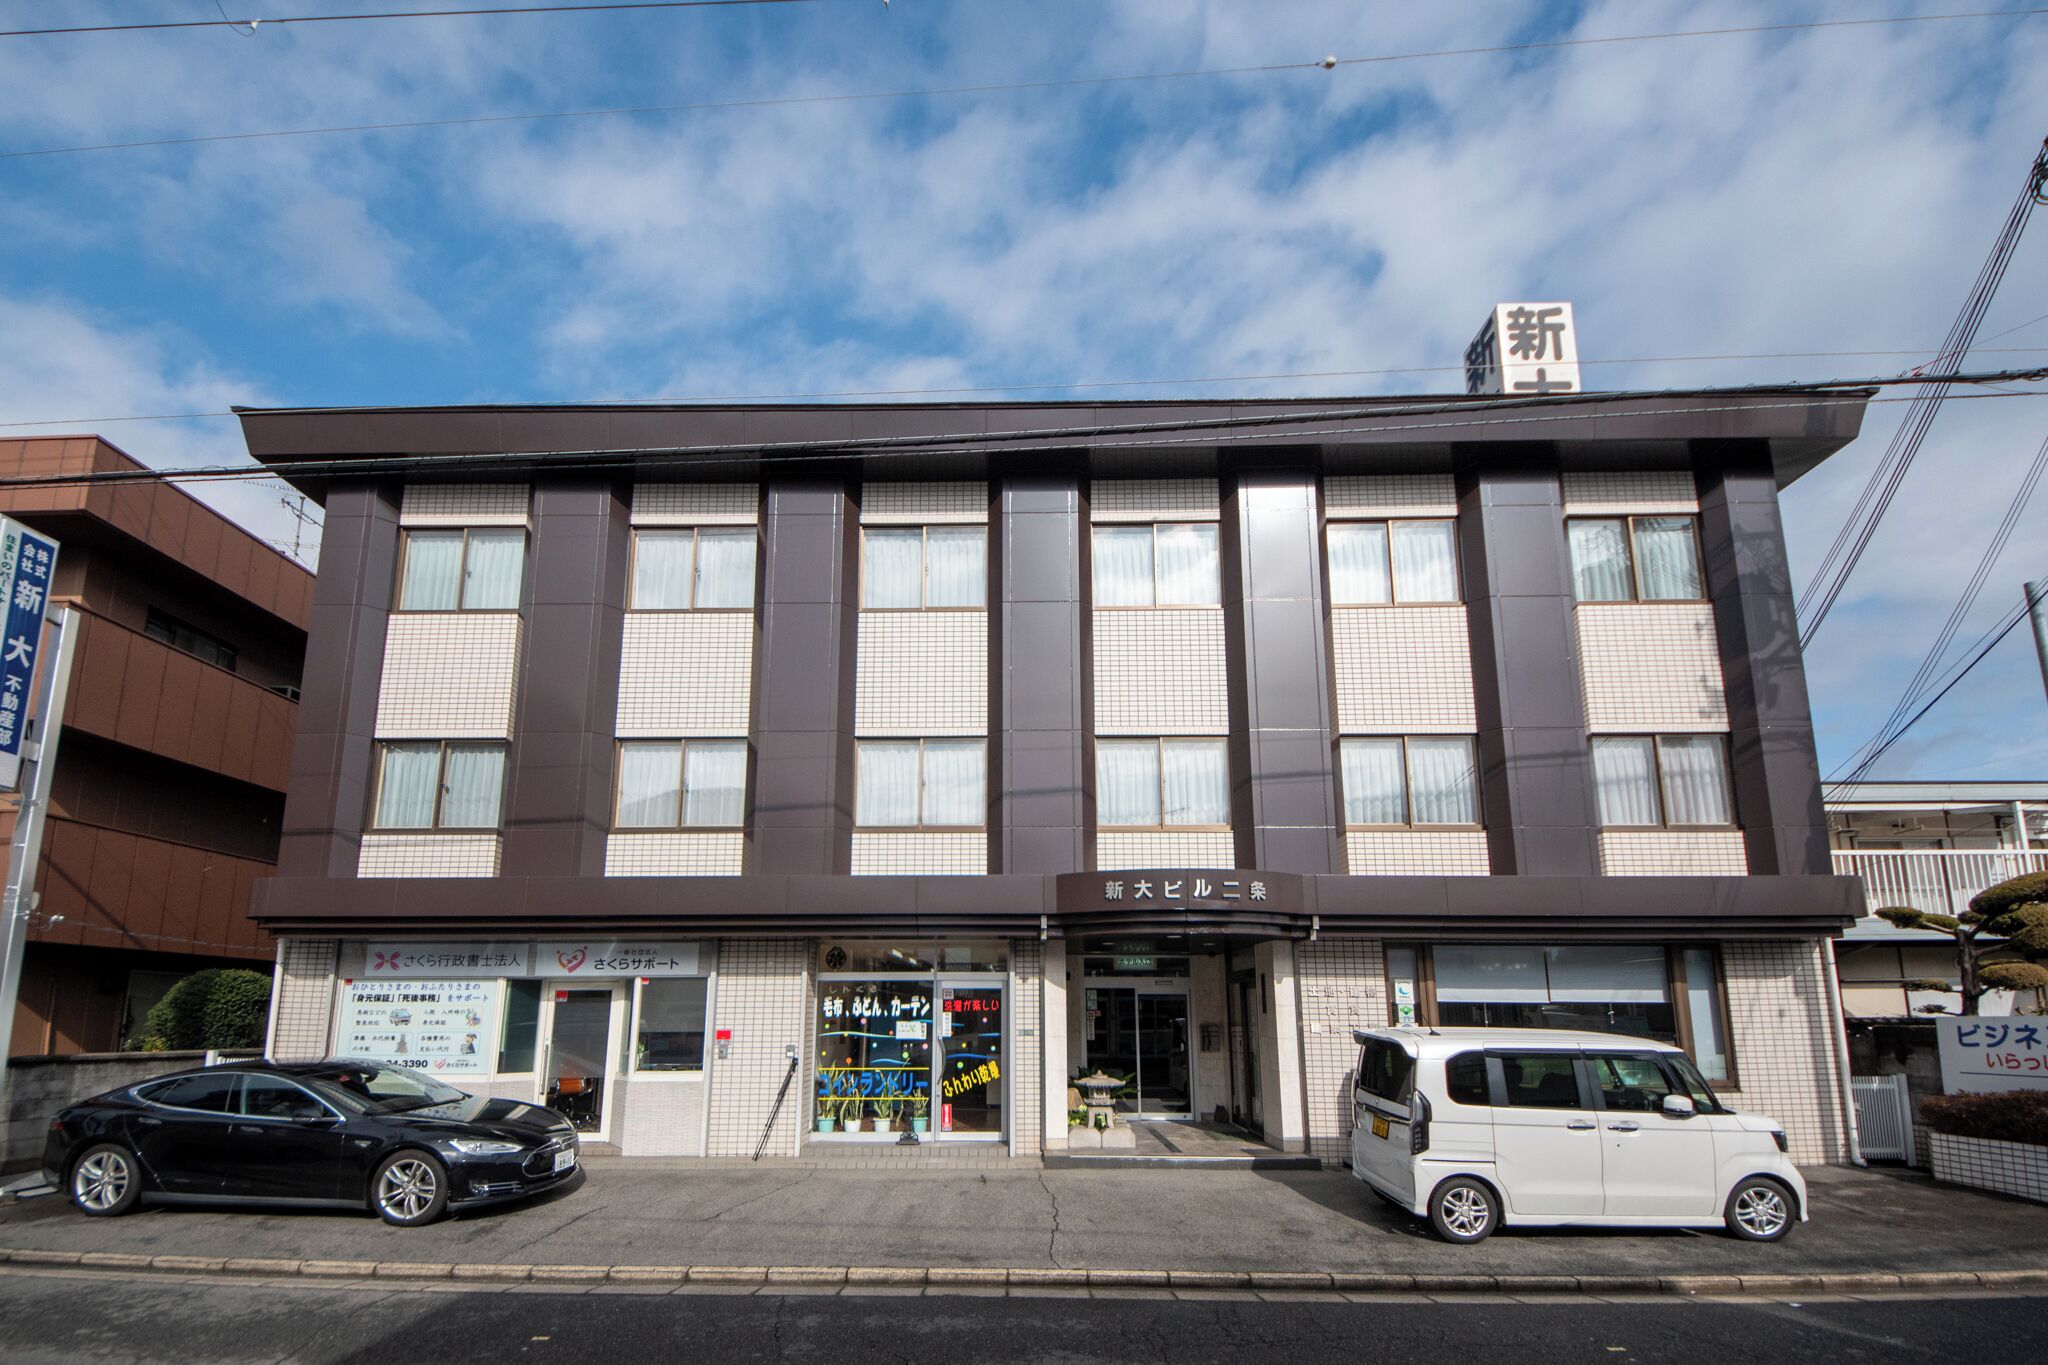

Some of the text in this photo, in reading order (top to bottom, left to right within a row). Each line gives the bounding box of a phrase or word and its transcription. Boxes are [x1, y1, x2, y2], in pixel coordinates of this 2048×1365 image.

[1105, 879, 1267, 901] 新大ビル二条
[403, 953, 521, 968] さくら行政書士法人
[594, 956, 680, 970] さくらサポート
[823, 996, 931, 1018] 毛布、ふとん、カーテン
[1957, 1024, 2048, 1050] ビジネ
[818, 1072, 928, 1096] コインランドリー
[943, 1060, 1000, 1097] ふんわり乾燥
